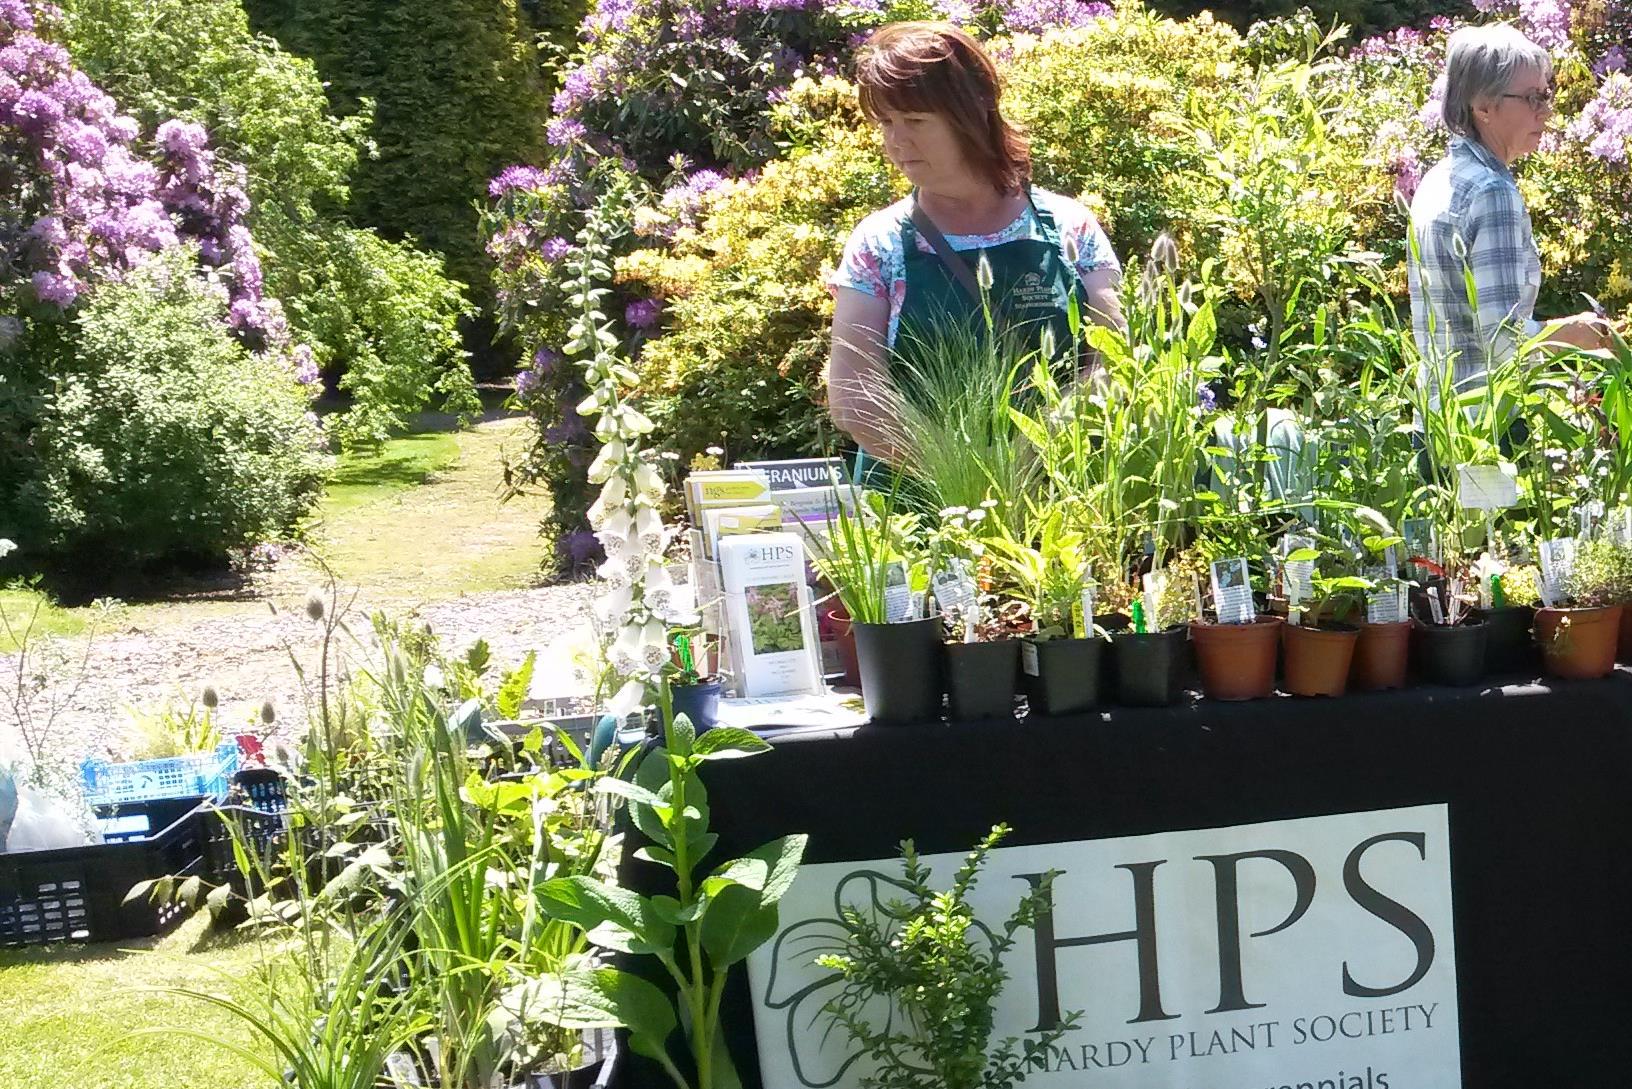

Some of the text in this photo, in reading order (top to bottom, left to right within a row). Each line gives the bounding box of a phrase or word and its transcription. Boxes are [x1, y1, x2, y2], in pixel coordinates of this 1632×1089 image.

[763, 465, 842, 484] ERANIUMS
[761, 546, 794, 561] HPS
[1011, 831, 1436, 1033] HPS
[1169, 1021, 1280, 1060] PLANT
[1293, 1002, 1440, 1045] SOCIETY
